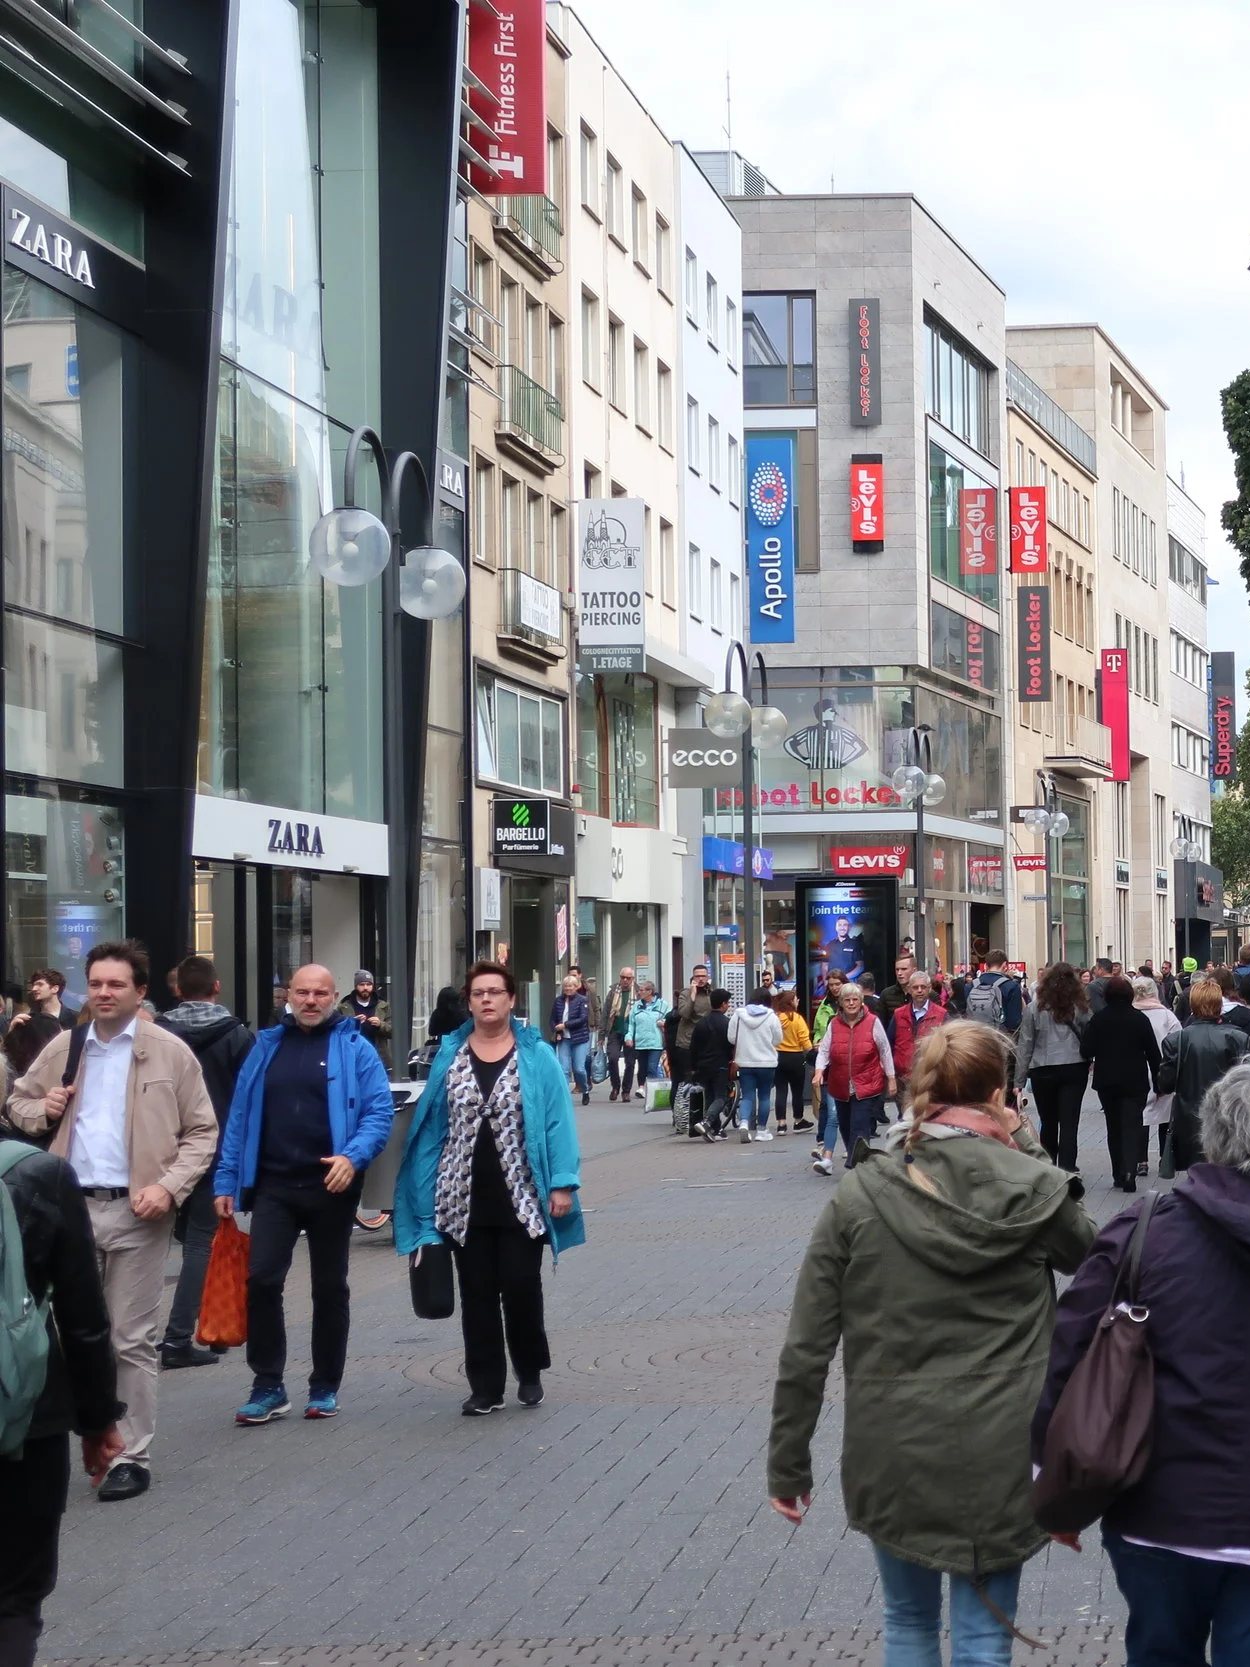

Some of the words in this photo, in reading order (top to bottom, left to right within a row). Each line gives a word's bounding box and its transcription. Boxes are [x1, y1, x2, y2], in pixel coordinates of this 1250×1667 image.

[493, 13, 518, 57] First
[494, 62, 518, 135] Fitness
[12, 208, 96, 289] ZARA
[859, 305, 870, 350] Foot
[860, 354, 871, 417] Locker
[440, 463, 465, 498] RA
[758, 537, 788, 620] Apollo
[581, 591, 641, 609] TATTOO
[581, 612, 641, 626] PIERCING
[1026, 592, 1041, 653] Locker
[582, 647, 641, 655] COLOGNECITYTATTOO
[1026, 657, 1042, 696] Foot
[672, 749, 737, 767] ecco
[268, 818, 325, 856] ZARA
[496, 827, 545, 841] BARGELLO
[502, 843, 539, 851] Parfümerie
[811, 905, 831, 917] Join
[832, 905, 850, 915] the
